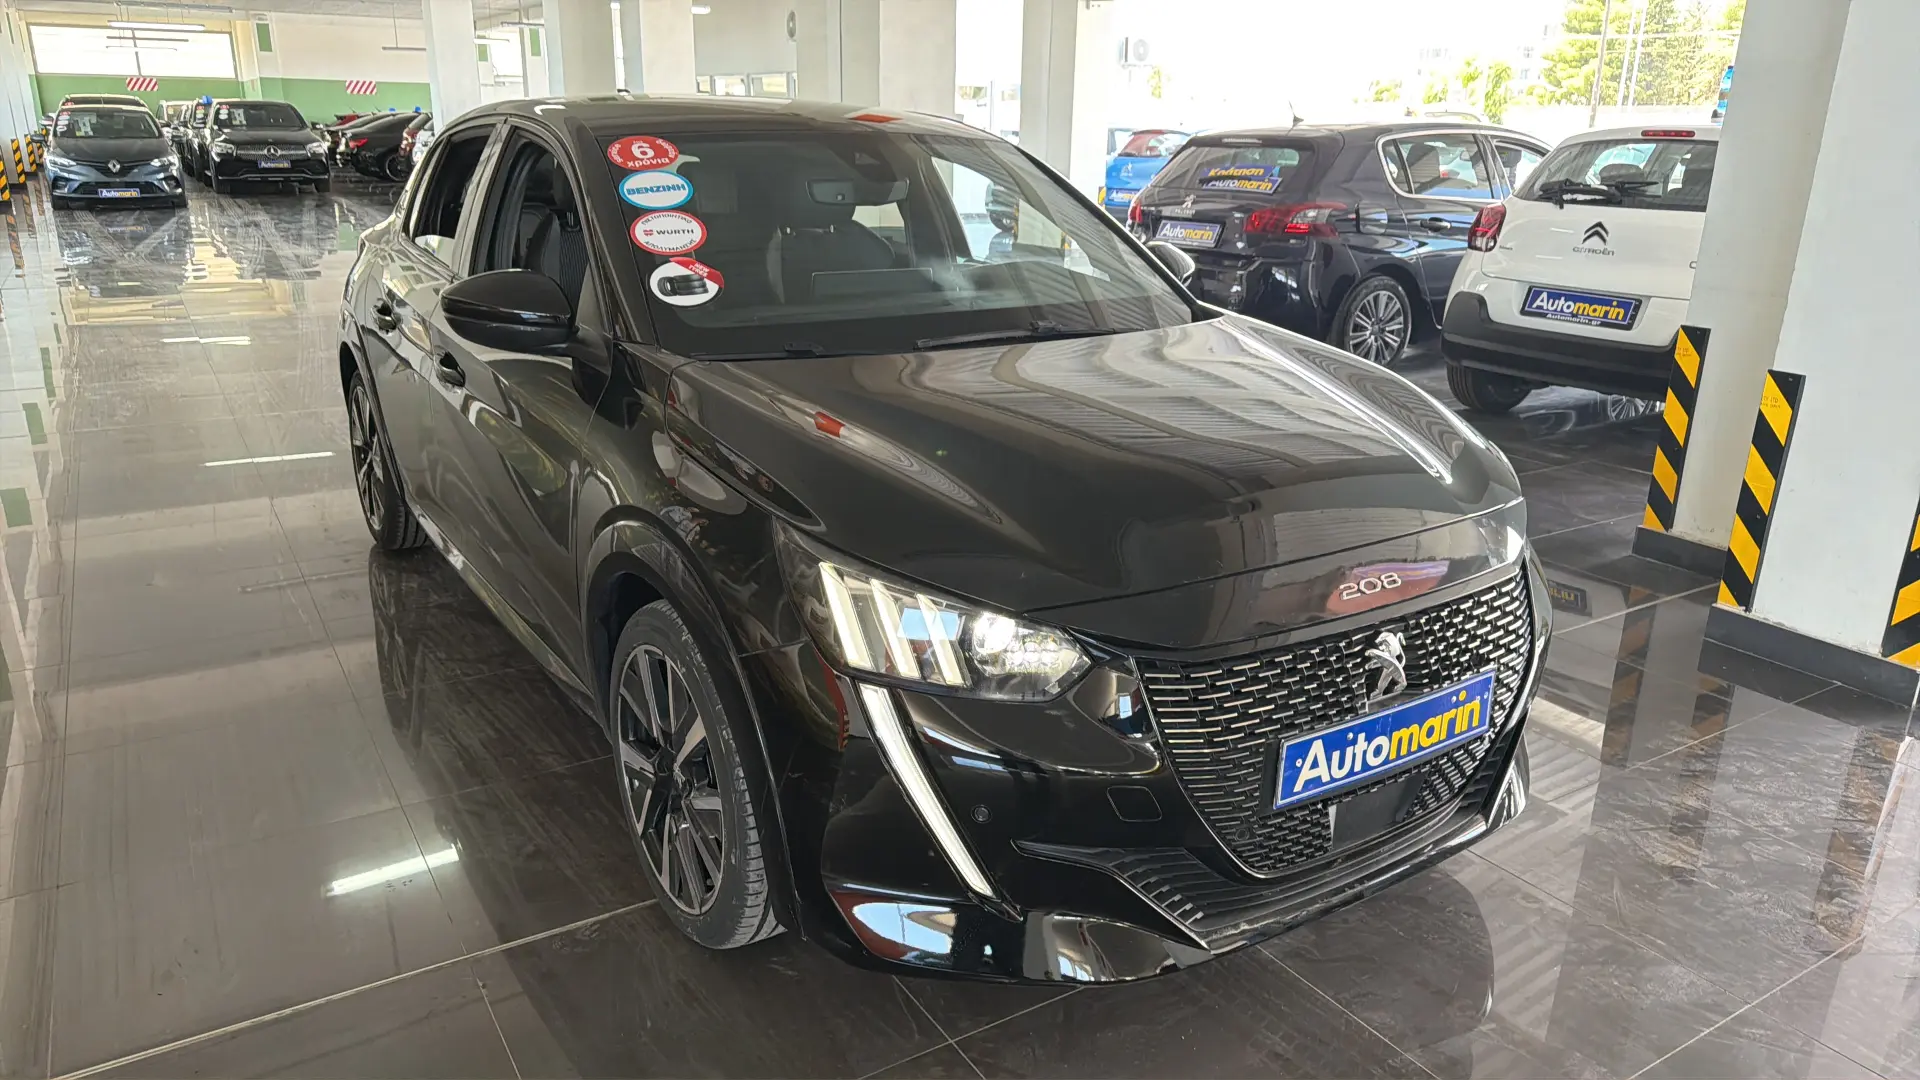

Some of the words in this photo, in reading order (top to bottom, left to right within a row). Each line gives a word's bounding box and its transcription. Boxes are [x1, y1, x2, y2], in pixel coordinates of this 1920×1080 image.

[631, 142, 655, 159] 6
[626, 157, 670, 168] χρόνια
[102, 189, 138, 197] Automarin
[1160, 223, 1213, 240] Automarin
[1532, 291, 1625, 321] Automarin
[1339, 571, 1402, 600] 208
[1293, 690, 1481, 793] Automarin
